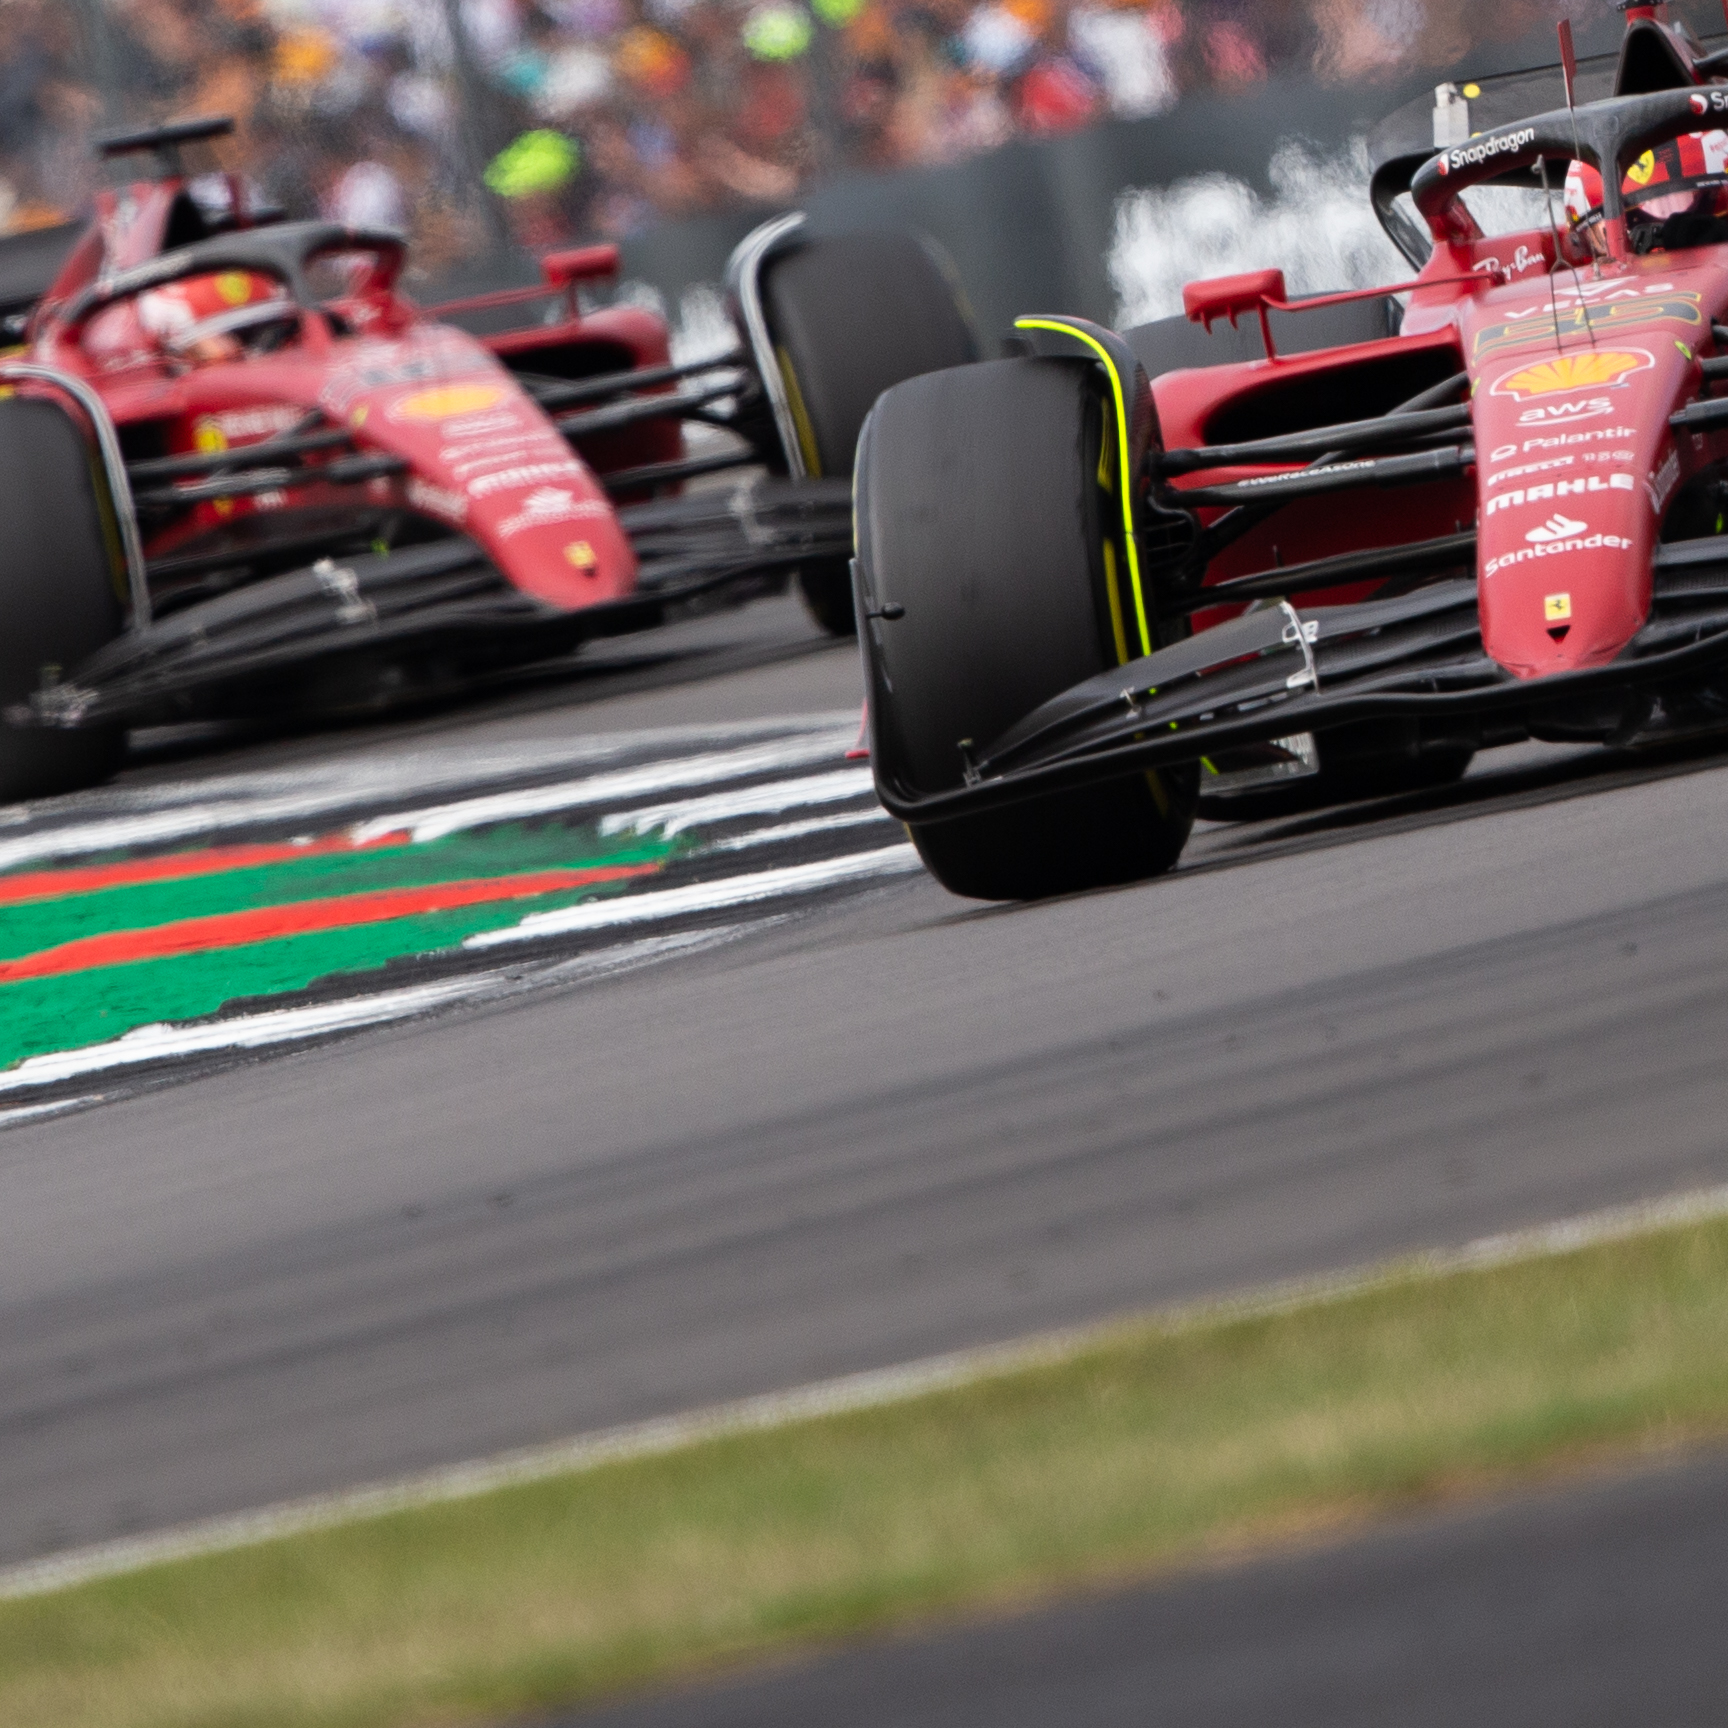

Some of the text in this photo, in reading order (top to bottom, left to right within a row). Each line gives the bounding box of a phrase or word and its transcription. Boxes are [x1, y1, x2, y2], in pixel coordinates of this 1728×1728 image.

[1450, 127, 1535, 169] Snapdragon
[1504, 282, 1673, 319] VELAS
[1472, 290, 1703, 368] 55
[1519, 396, 1613, 423] aws
[1522, 425, 1637, 454] Palantir
[1486, 473, 1636, 516] MAHLE
[1484, 533, 1634, 579] Santander
